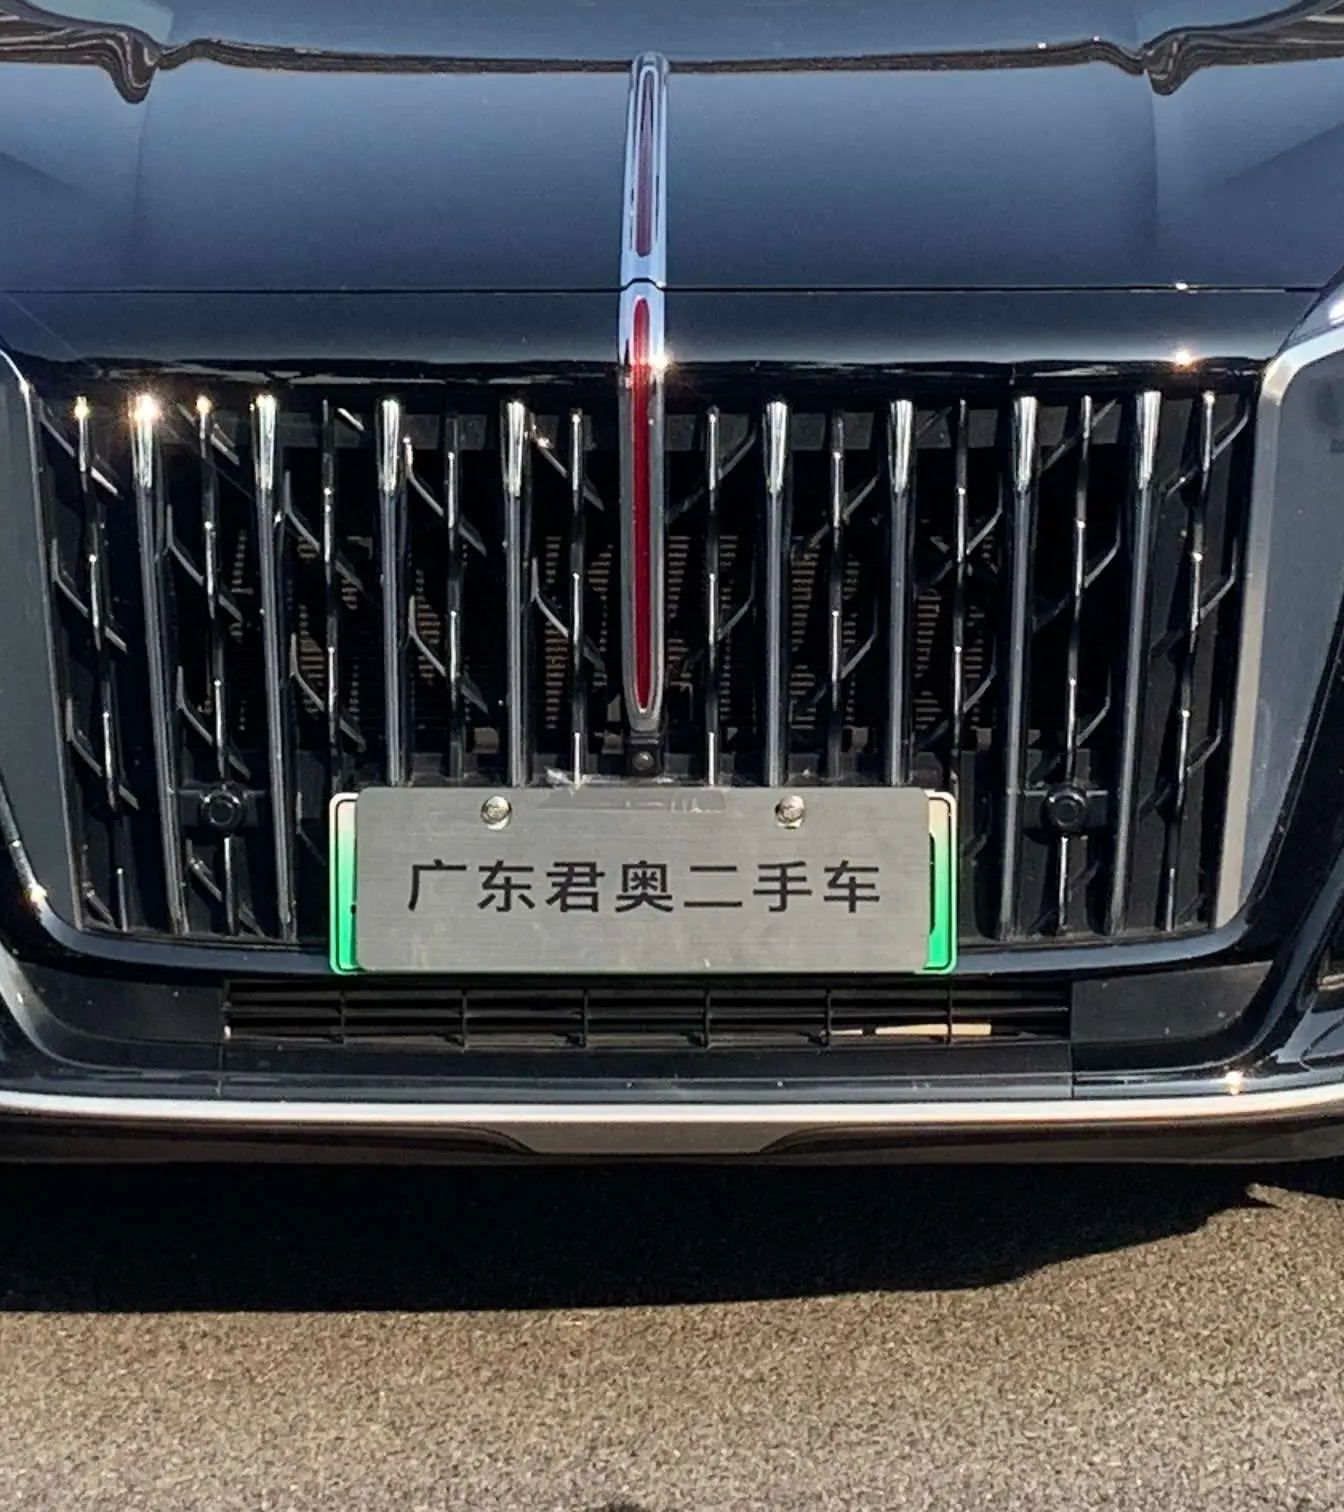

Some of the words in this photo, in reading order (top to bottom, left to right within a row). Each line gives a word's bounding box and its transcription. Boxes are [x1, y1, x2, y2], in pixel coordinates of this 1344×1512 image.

[407, 859, 882, 913] 广东君奥二手车
